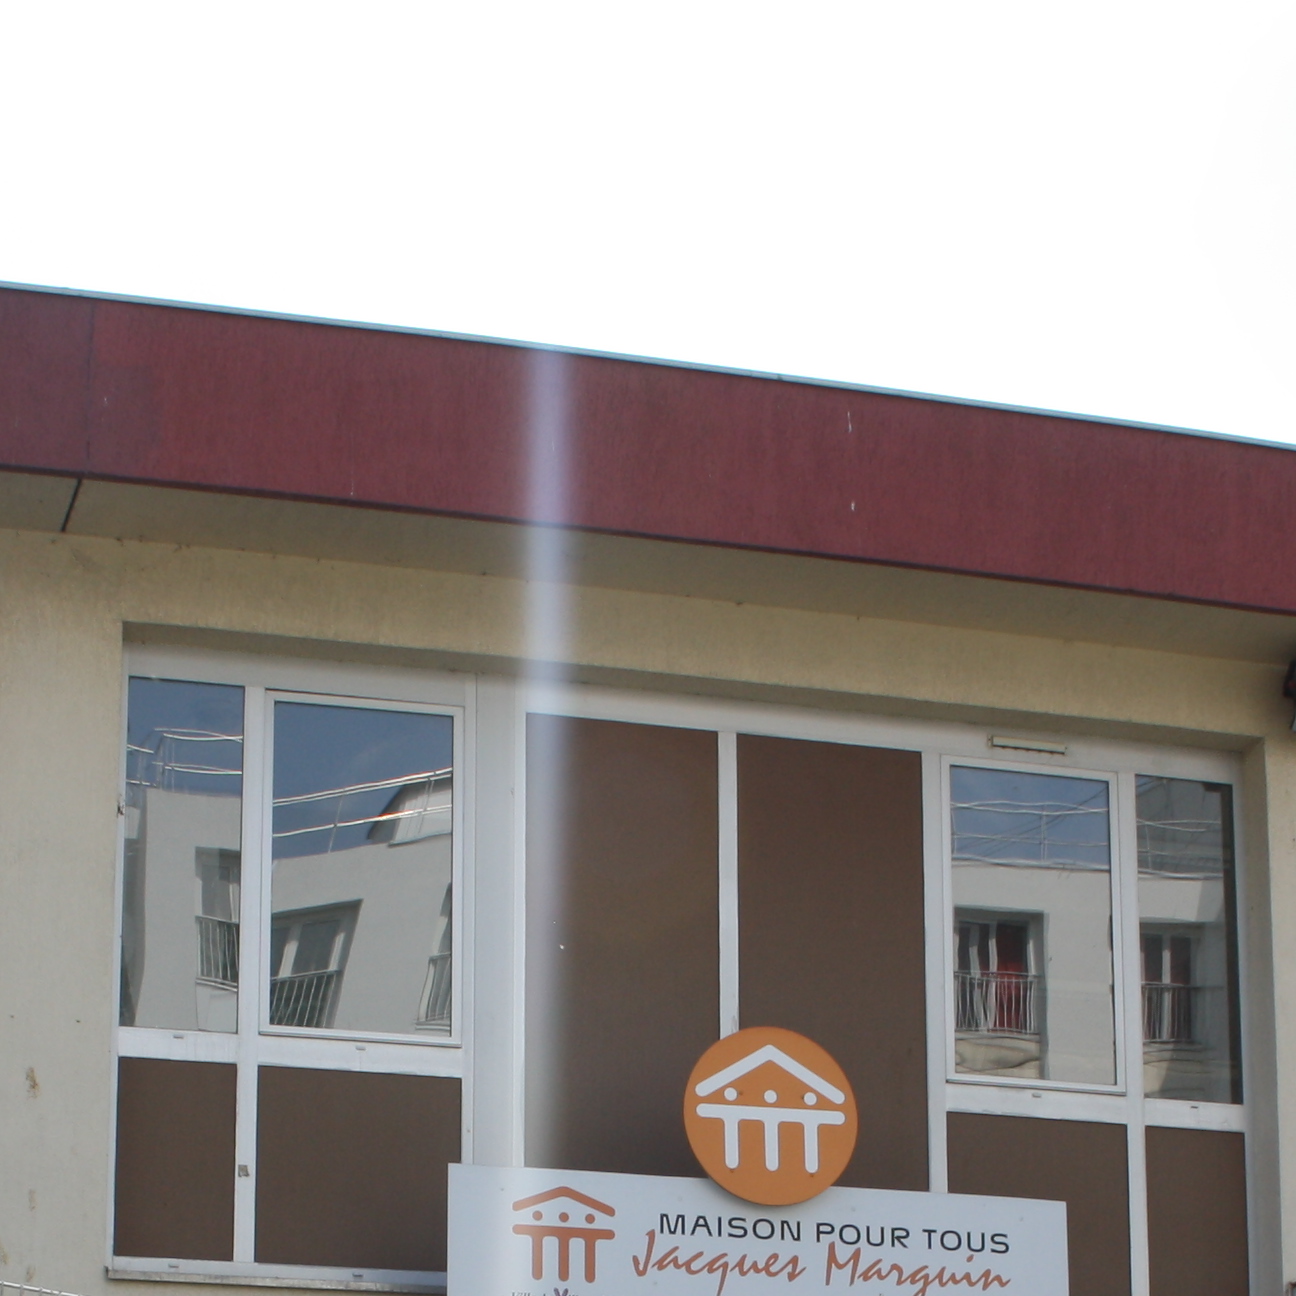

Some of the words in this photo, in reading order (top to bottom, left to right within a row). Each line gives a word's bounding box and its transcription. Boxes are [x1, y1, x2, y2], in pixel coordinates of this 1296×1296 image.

[659, 1212, 802, 1242] MAISON
[815, 1221, 911, 1250] POUR
[922, 1228, 1011, 1254] TOUS
